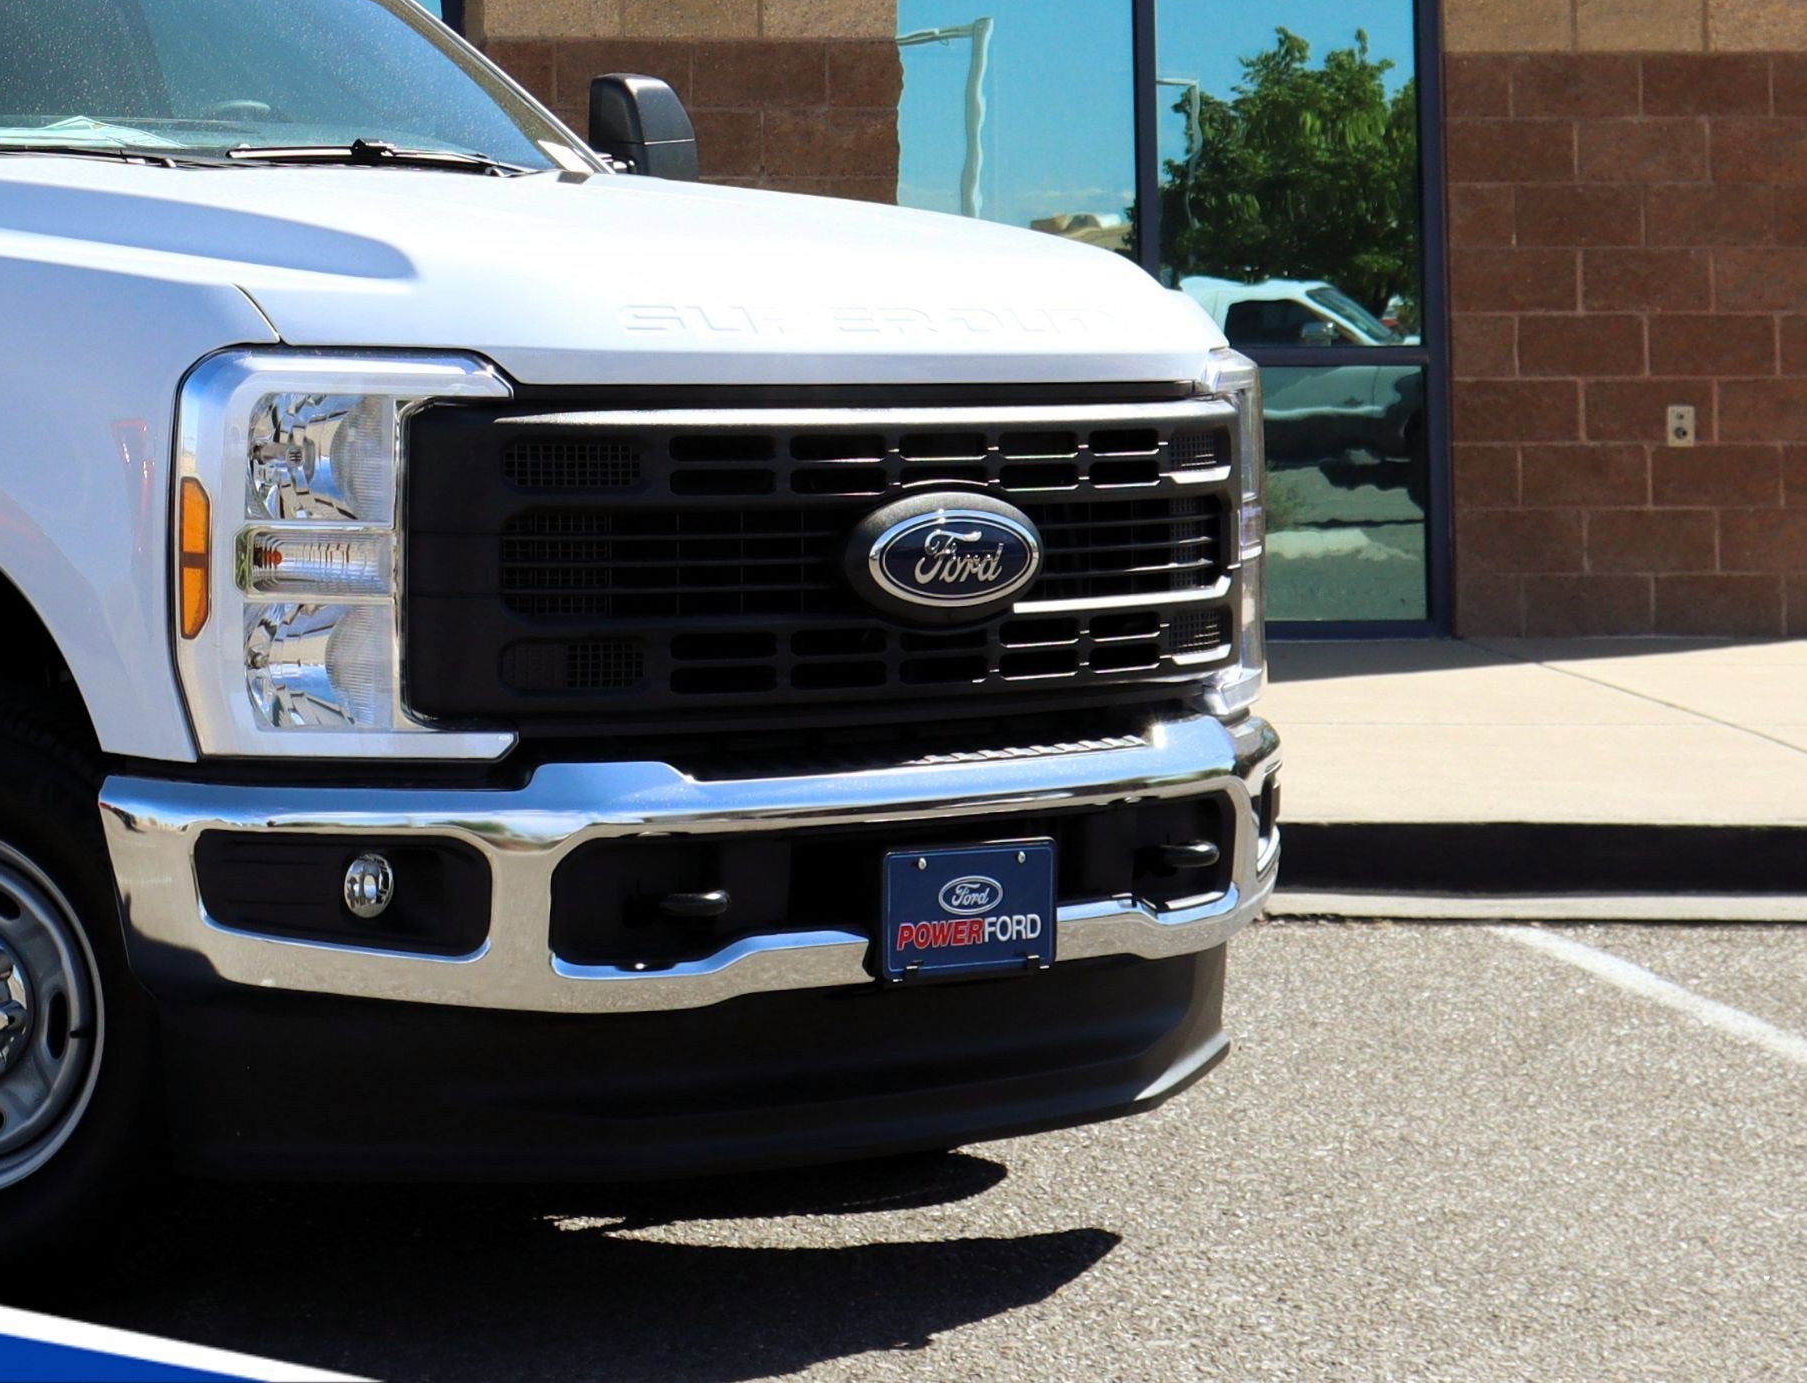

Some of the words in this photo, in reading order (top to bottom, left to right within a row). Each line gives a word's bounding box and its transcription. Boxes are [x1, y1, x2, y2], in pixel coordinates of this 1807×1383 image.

[914, 529, 1005, 585] Ford
[951, 882, 991, 907] Ford
[897, 914, 1042, 951] POWERFORD
